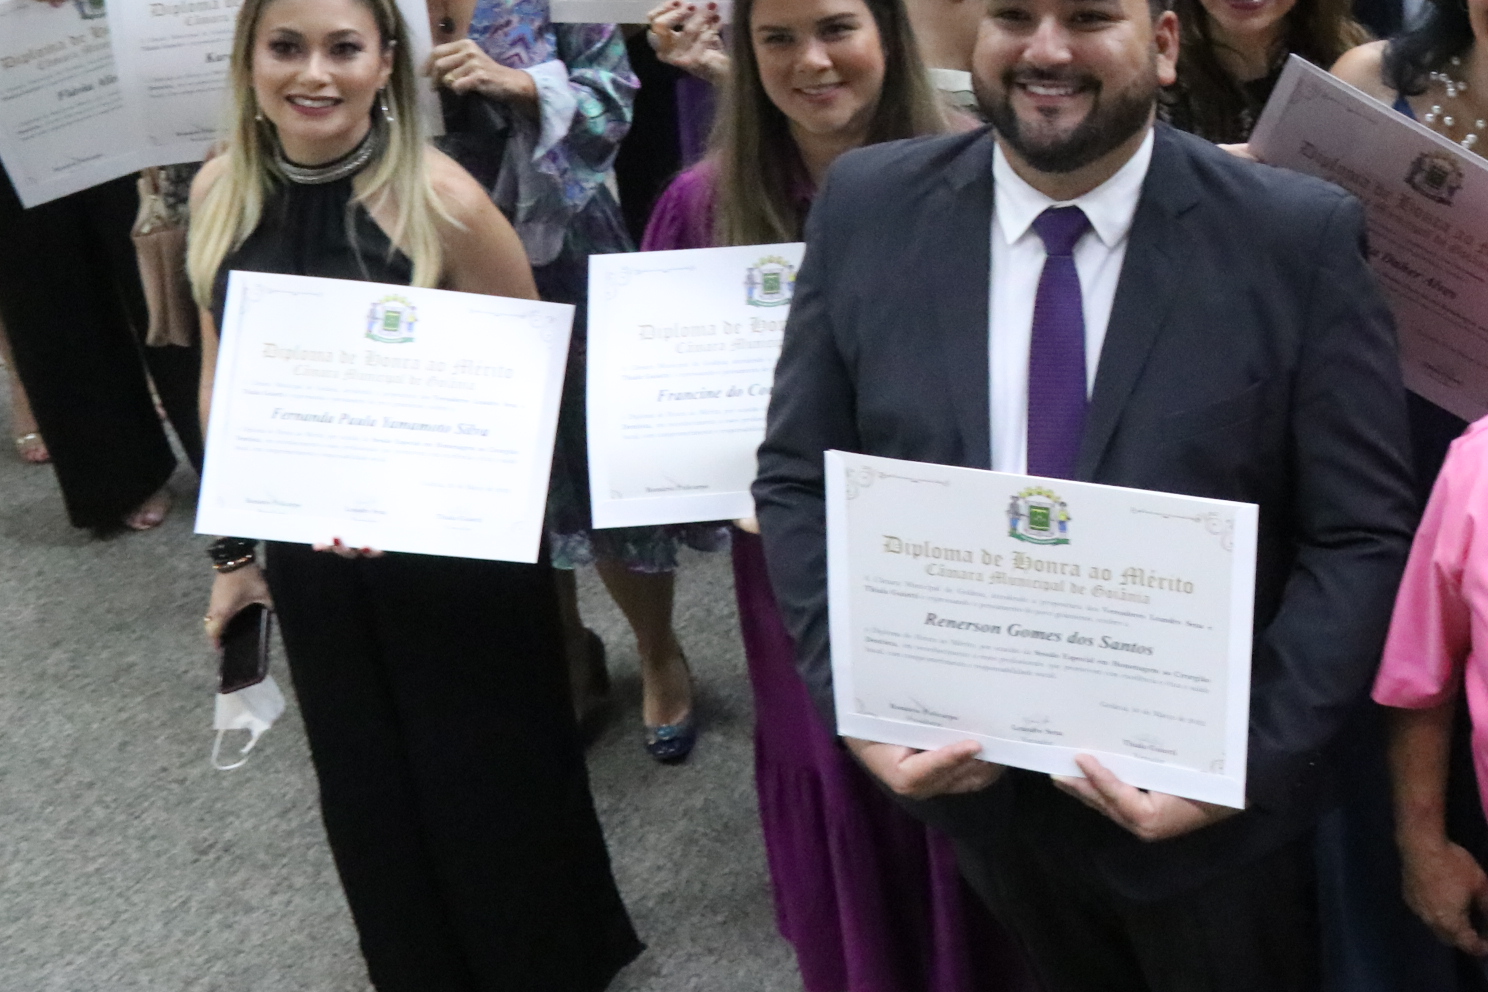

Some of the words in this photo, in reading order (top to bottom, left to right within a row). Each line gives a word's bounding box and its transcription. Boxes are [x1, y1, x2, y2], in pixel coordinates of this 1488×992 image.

[638, 322, 717, 342] Diploma
[262, 342, 334, 364] Diploma
[340, 349, 357, 365] de
[366, 349, 420, 371] Honra
[425, 359, 447, 373] ao
[452, 358, 515, 380] Mérito
[881, 533, 974, 565] Diploma
[980, 548, 1004, 568] de
[1012, 551, 1081, 578] Honra
[1088, 566, 1112, 583] ao
[1118, 566, 1196, 596] Mérito
[925, 563, 984, 583] Câmara
[988, 570, 1065, 593] Municipal
[1070, 581, 1086, 596] de
[1089, 584, 1151, 606] Goiânia
[924, 612, 1002, 635] Renerson
[1006, 624, 1062, 644] Gomes
[1066, 631, 1095, 648] dos
[1098, 635, 1155, 656] Santos
